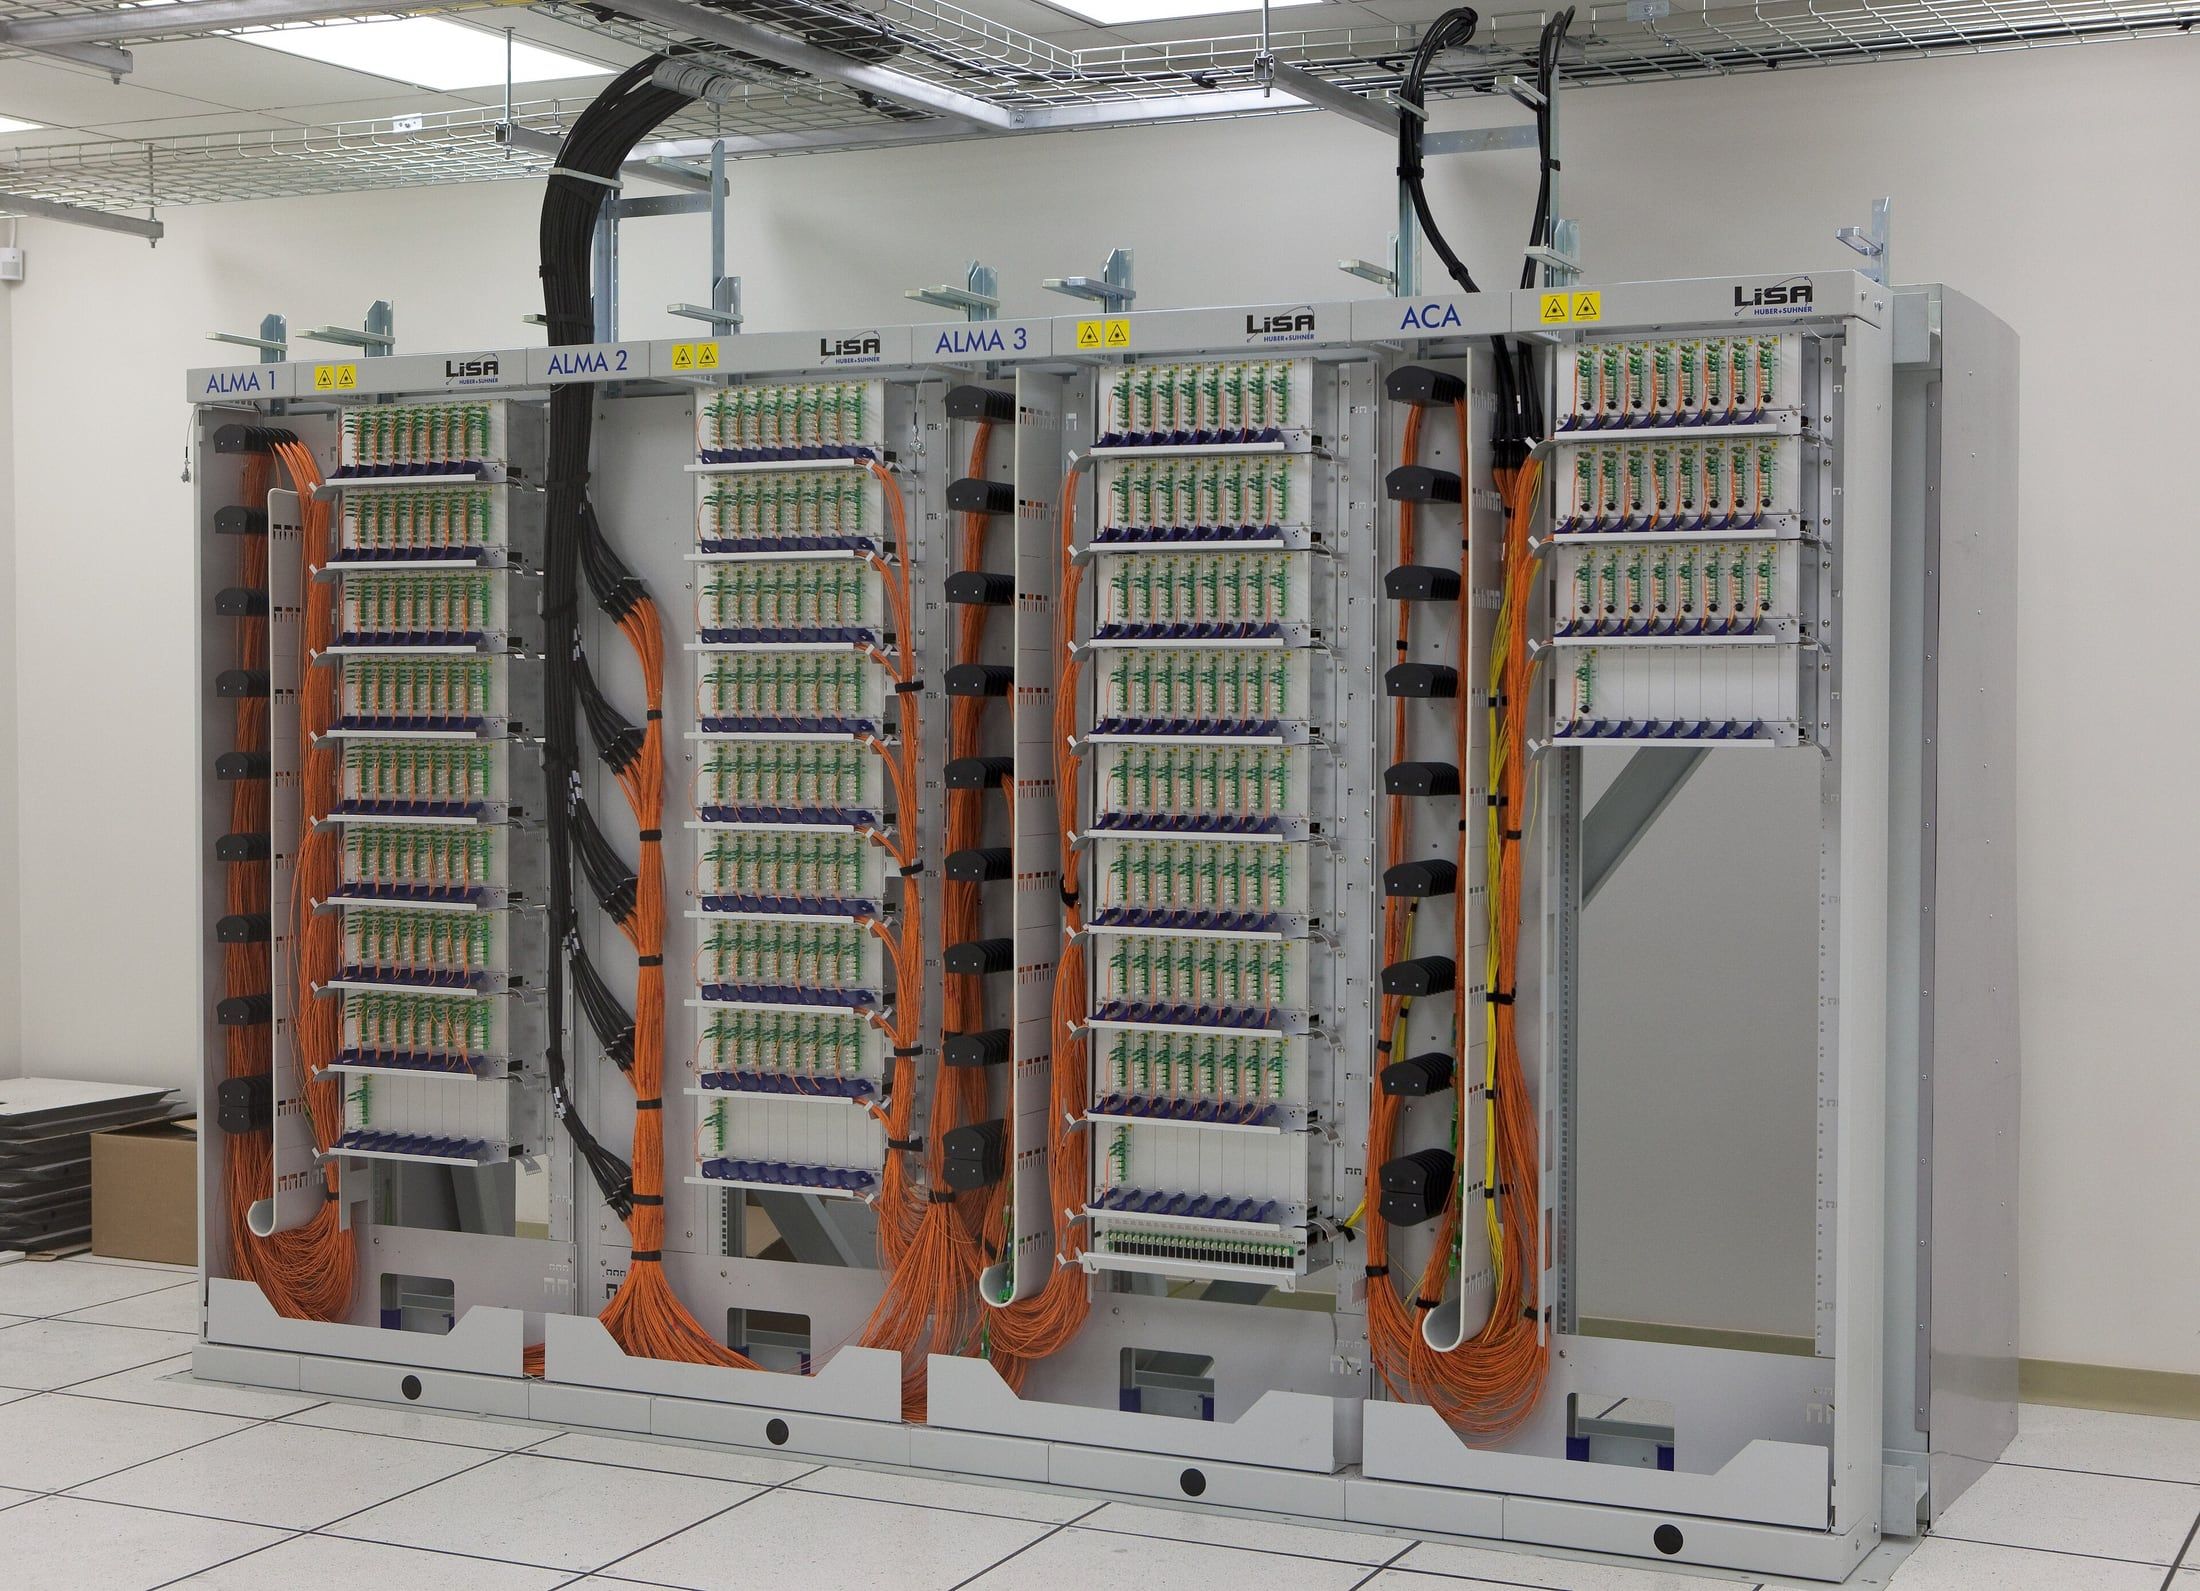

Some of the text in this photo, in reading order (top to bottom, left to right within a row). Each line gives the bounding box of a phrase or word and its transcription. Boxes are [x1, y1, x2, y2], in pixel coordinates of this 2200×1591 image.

[1734, 285, 1813, 307] LiSA
[1400, 303, 1462, 330] ACA
[1754, 306, 1813, 315] HUBER+SUHNER
[1246, 314, 1315, 334] LiSA
[820, 338, 881, 356] LiSA
[935, 328, 1027, 354] ALMA 3
[1263, 333, 1315, 342] HUBER+SUHNER
[445, 360, 499, 378] LiSA
[547, 350, 628, 375] ALMA 2
[835, 356, 881, 364] HUBER+SUHNER
[206, 370, 275, 394] ALMA 1
